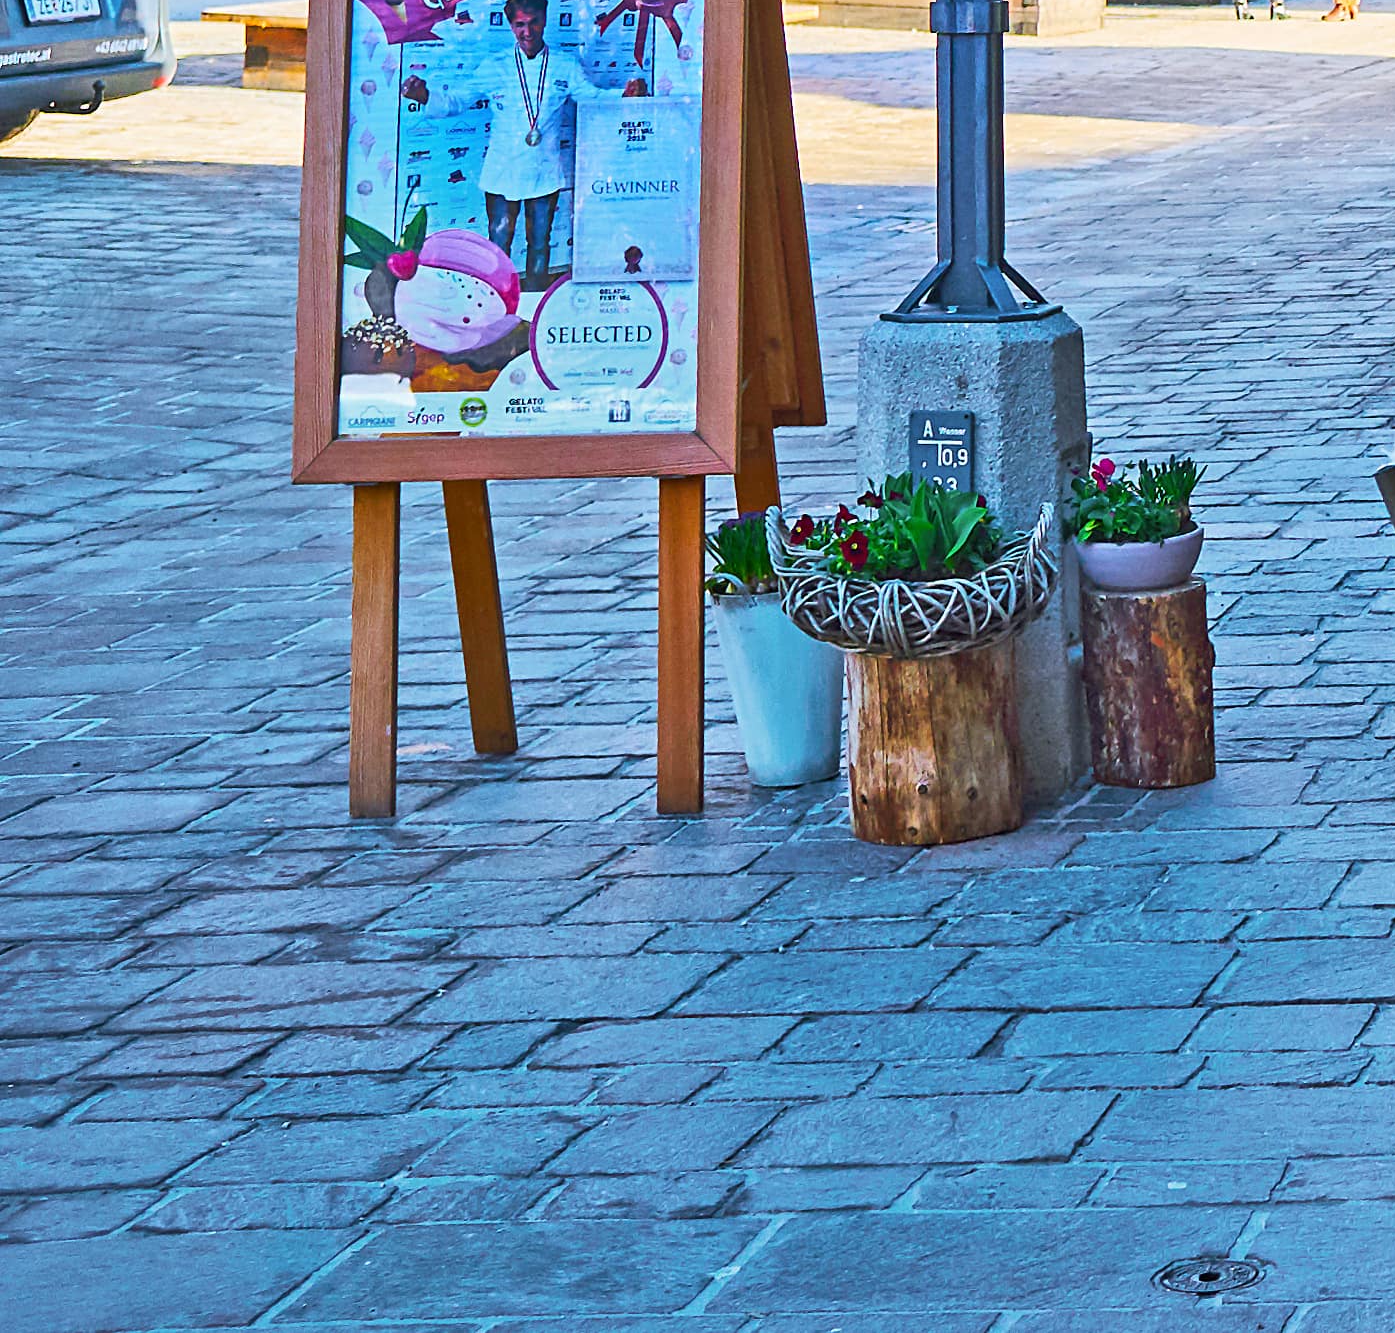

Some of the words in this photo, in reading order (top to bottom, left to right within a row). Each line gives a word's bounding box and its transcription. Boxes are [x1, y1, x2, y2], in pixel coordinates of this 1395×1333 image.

[591, 179, 681, 195] GEWINNER
[546, 325, 652, 345] SELECTED
[505, 405, 548, 414] FESTIVAL
[508, 398, 544, 406] GELATO
[923, 419, 934, 438] A
